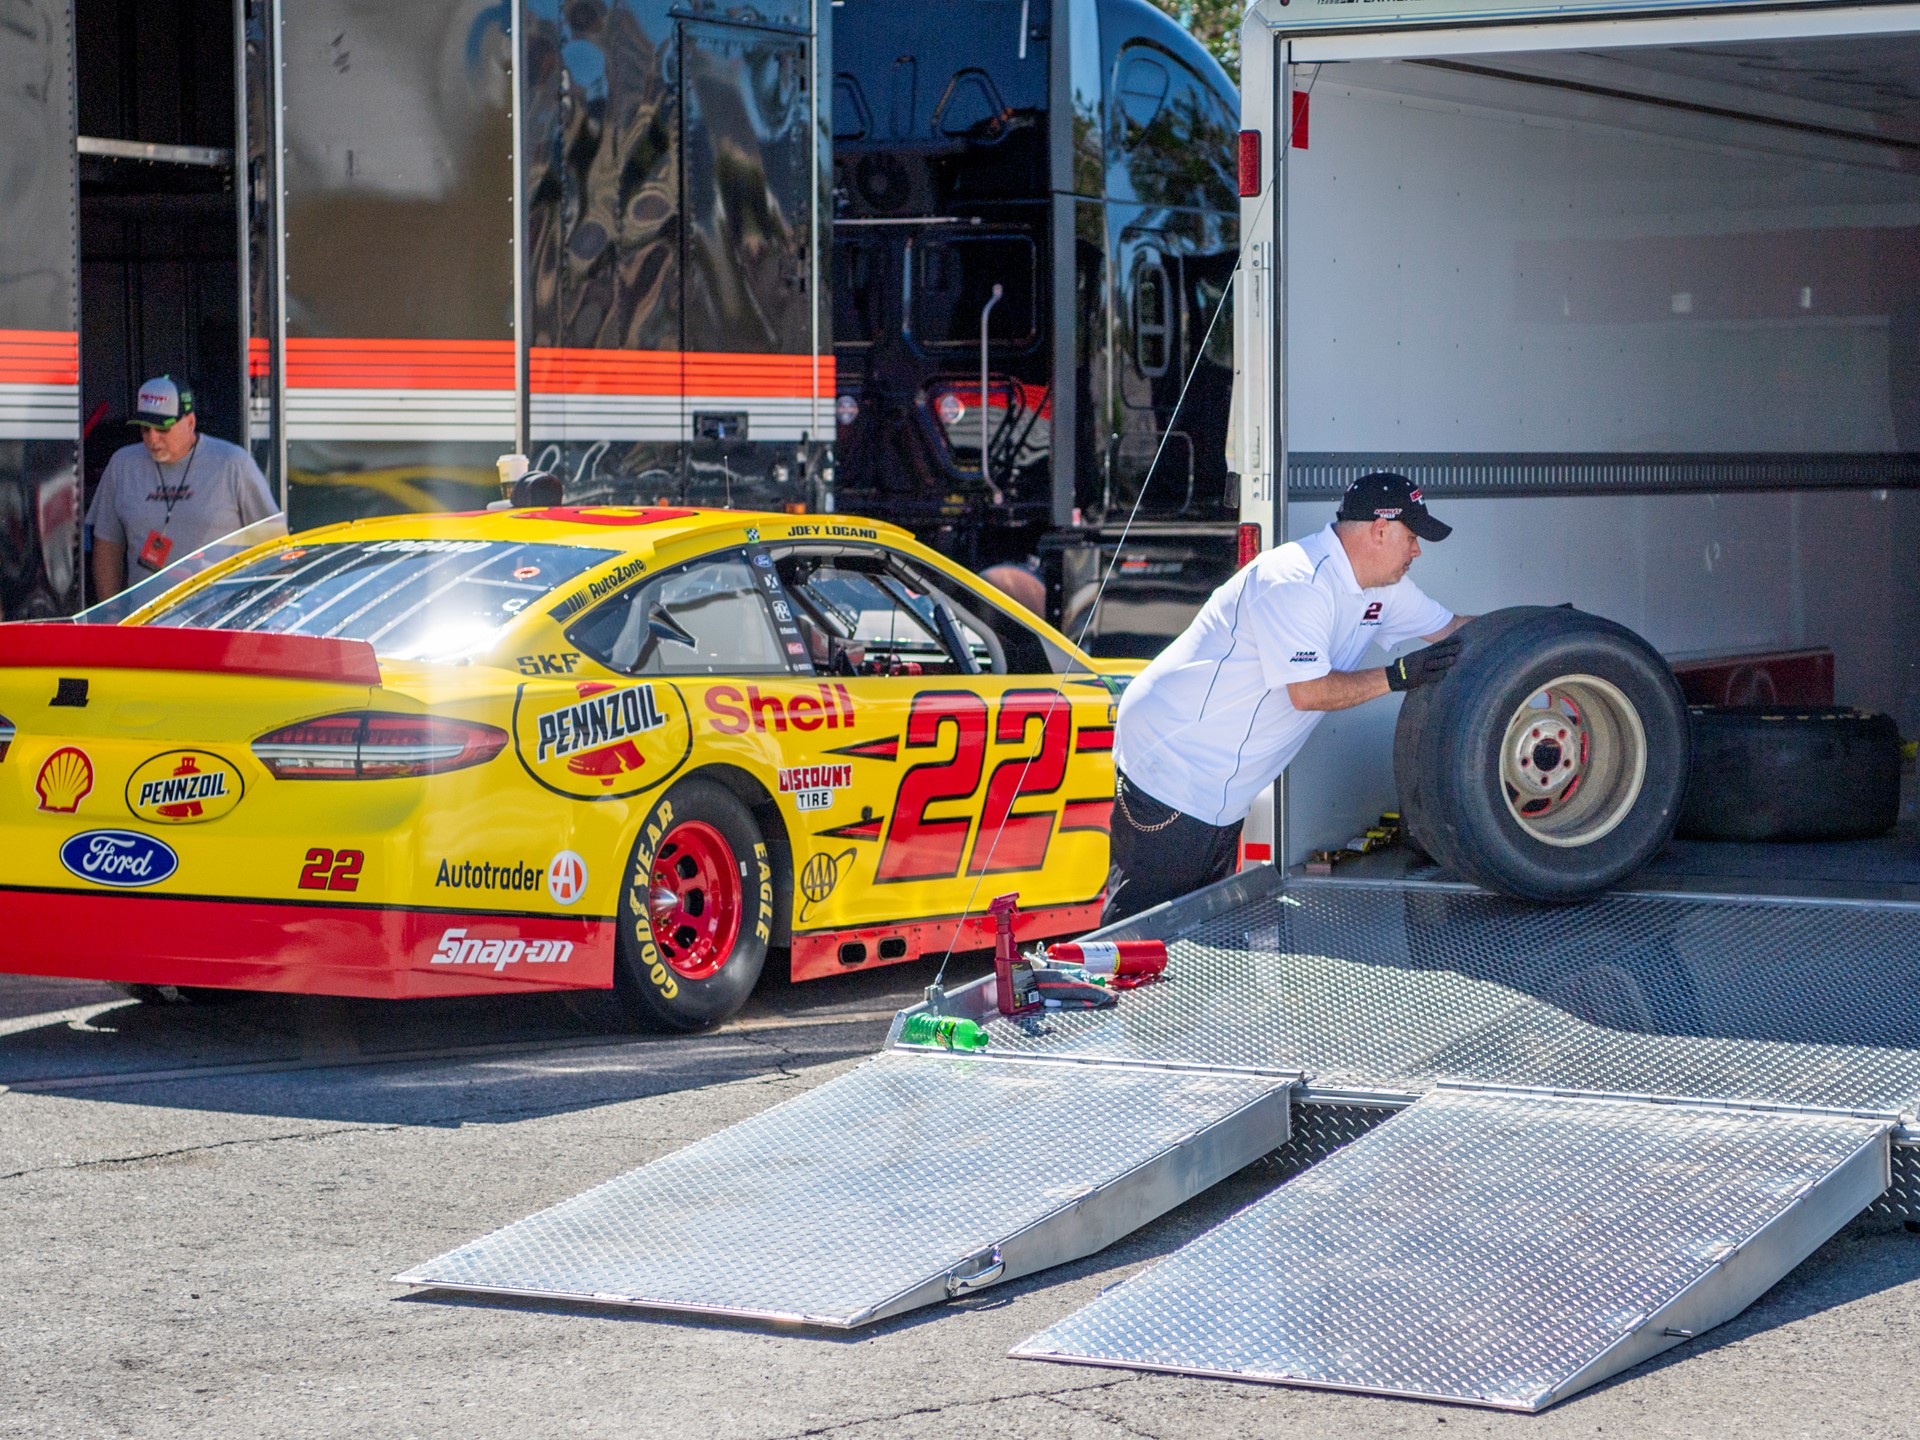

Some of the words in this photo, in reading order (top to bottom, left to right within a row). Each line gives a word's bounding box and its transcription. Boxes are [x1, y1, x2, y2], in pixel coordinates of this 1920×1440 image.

[788, 525, 820, 536] JOEY
[825, 525, 877, 539] LOGANO
[588, 559, 646, 599] AutoZone
[1363, 602, 1383, 620] 2
[516, 653, 581, 675] SKF
[538, 683, 665, 762] PENNZOIL
[705, 684, 855, 734] Shell
[138, 772, 229, 807] PENNZOIL
[778, 765, 852, 791] DISCOUNT
[874, 689, 1072, 885] 22
[799, 792, 828, 807] TIRE
[82, 836, 153, 876] Ford
[299, 848, 364, 892] 22
[435, 858, 543, 891] Autotrader
[630, 800, 678, 1000] GOODYEAR
[753, 842, 773, 945] EAGLE
[431, 928, 573, 971] Snap-on
